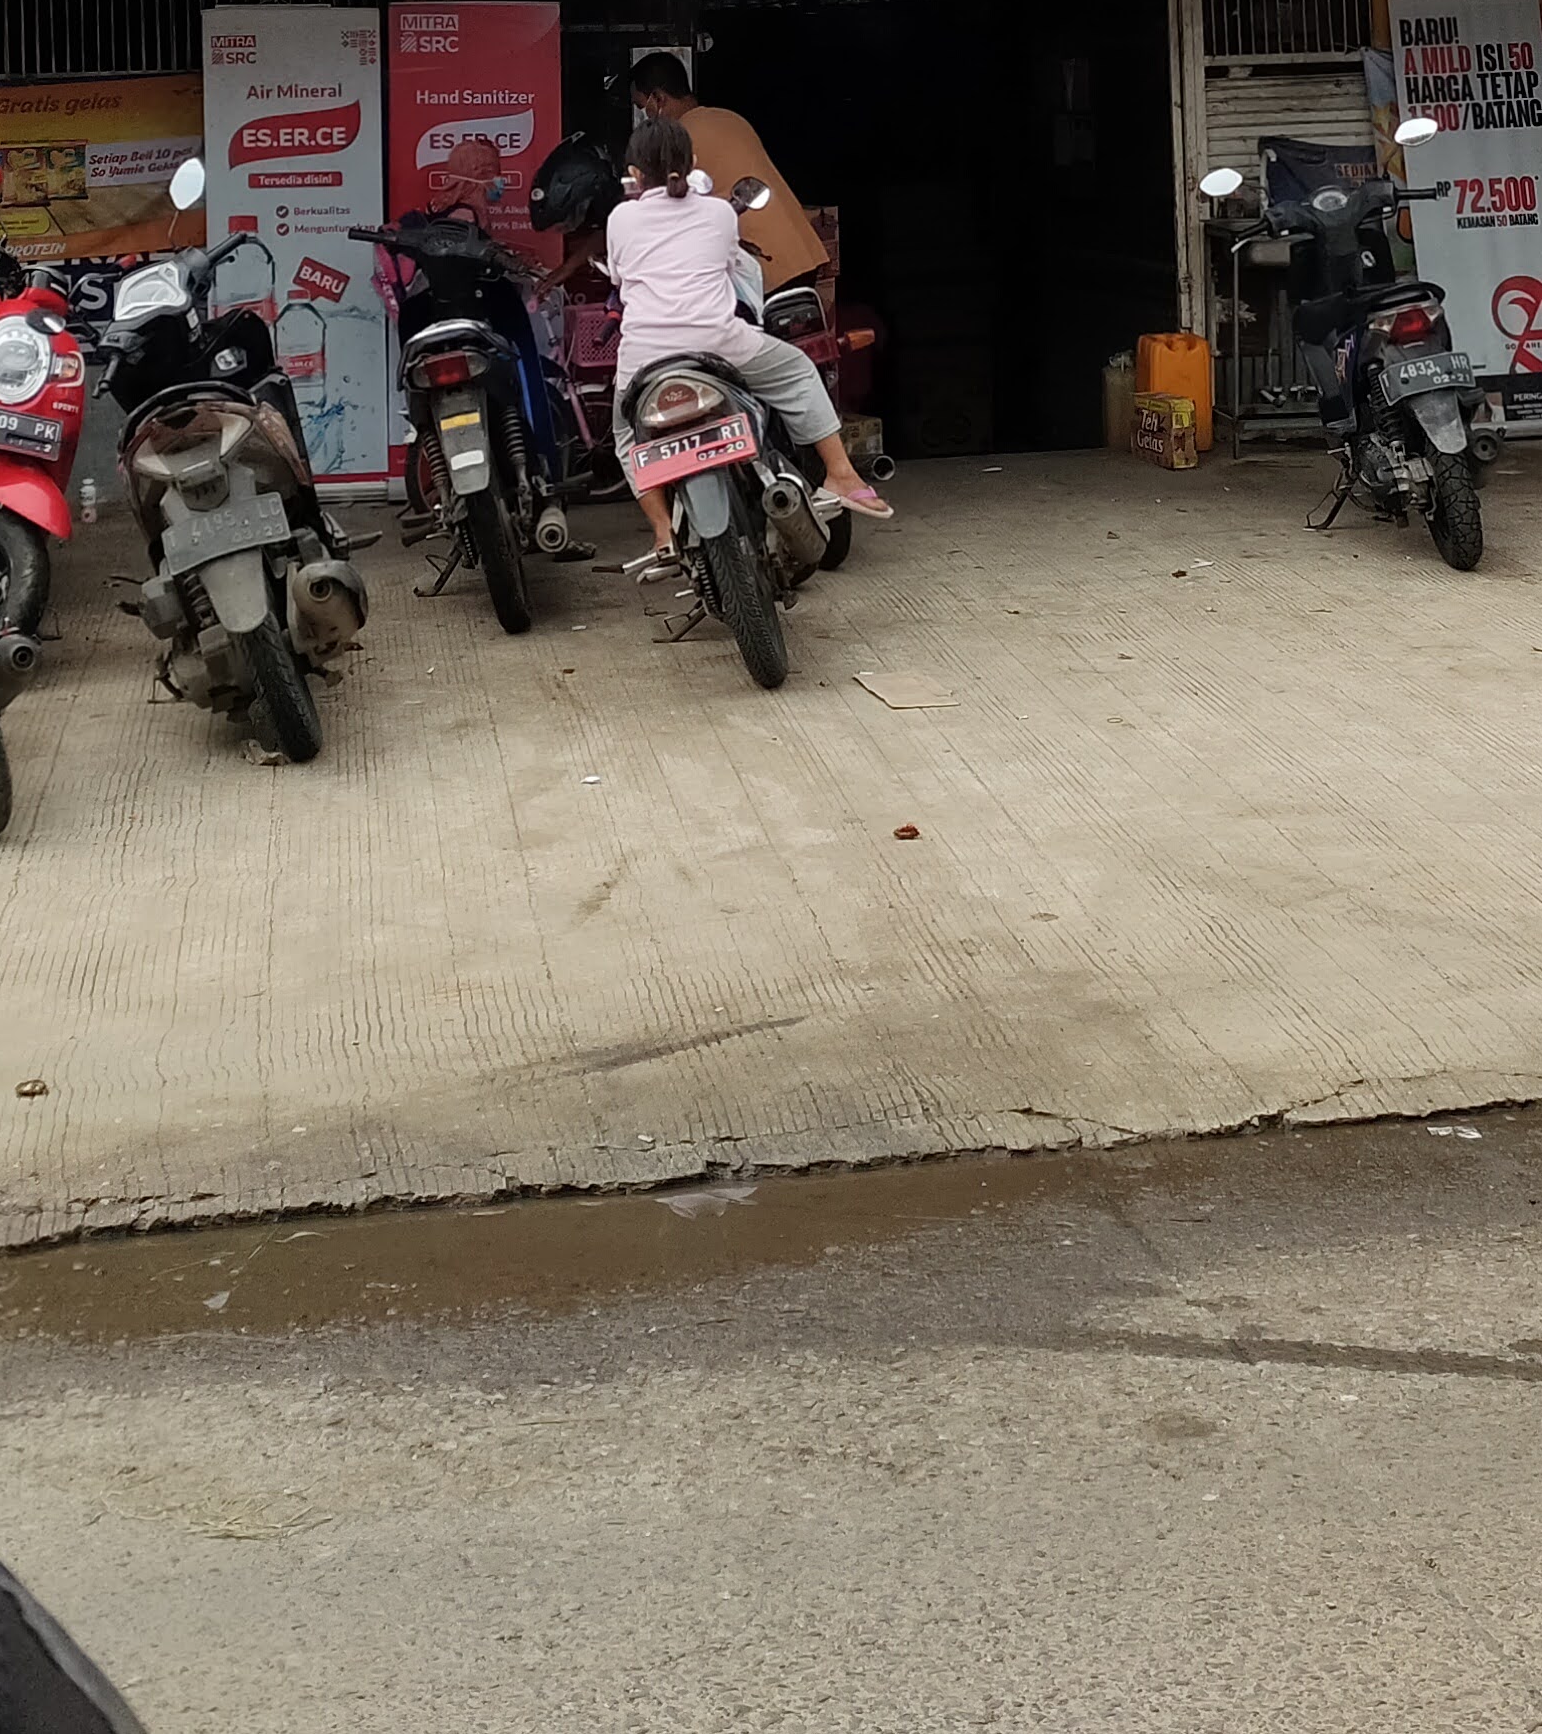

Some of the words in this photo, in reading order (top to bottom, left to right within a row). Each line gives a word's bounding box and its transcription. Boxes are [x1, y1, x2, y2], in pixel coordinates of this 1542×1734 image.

[400, 15, 458, 31] MITRA
[1398, 16, 1460, 47] BARU!
[211, 35, 256, 48] MITRA
[418, 36, 460, 54] SRC
[224, 51, 258, 65] SRC
[1404, 47, 1418, 75] A
[1421, 44, 1472, 75] MILD
[1475, 42, 1505, 72] ISI
[1507, 41, 1534, 70] 50
[246, 84, 274, 101] Air
[276, 82, 343, 100] Mineral
[415, 89, 460, 106] Hand
[462, 88, 536, 106] Sanitizer
[1405, 73, 1475, 105] HARGA
[1476, 70, 1540, 100] TETAP
[64, 92, 124, 115] gelas
[241, 125, 347, 148] ES.ER.CE
[429, 131, 522, 150] ESERCE
[88, 153, 128, 166] Setiap
[90, 167, 106, 178] So
[108, 164, 145, 178] Yumie
[258, 174, 303, 187] Tersedia
[304, 173, 333, 186] disini
[293, 205, 352, 217] Berkualitas
[1496, 214, 1508, 228] 50
[1508, 212, 1539, 227] BATANG
[297, 264, 348, 295] BARU
[1432, 373, 1471, 385] 02-21
[1139, 407, 1161, 433] Teh
[33, 421, 57, 440] PK
[638, 450, 650, 468] F
[659, 435, 701, 461] 5717
[720, 422, 742, 440] RT
[697, 441, 745, 462] 02-20
[1135, 429, 1166, 455] Gelas
